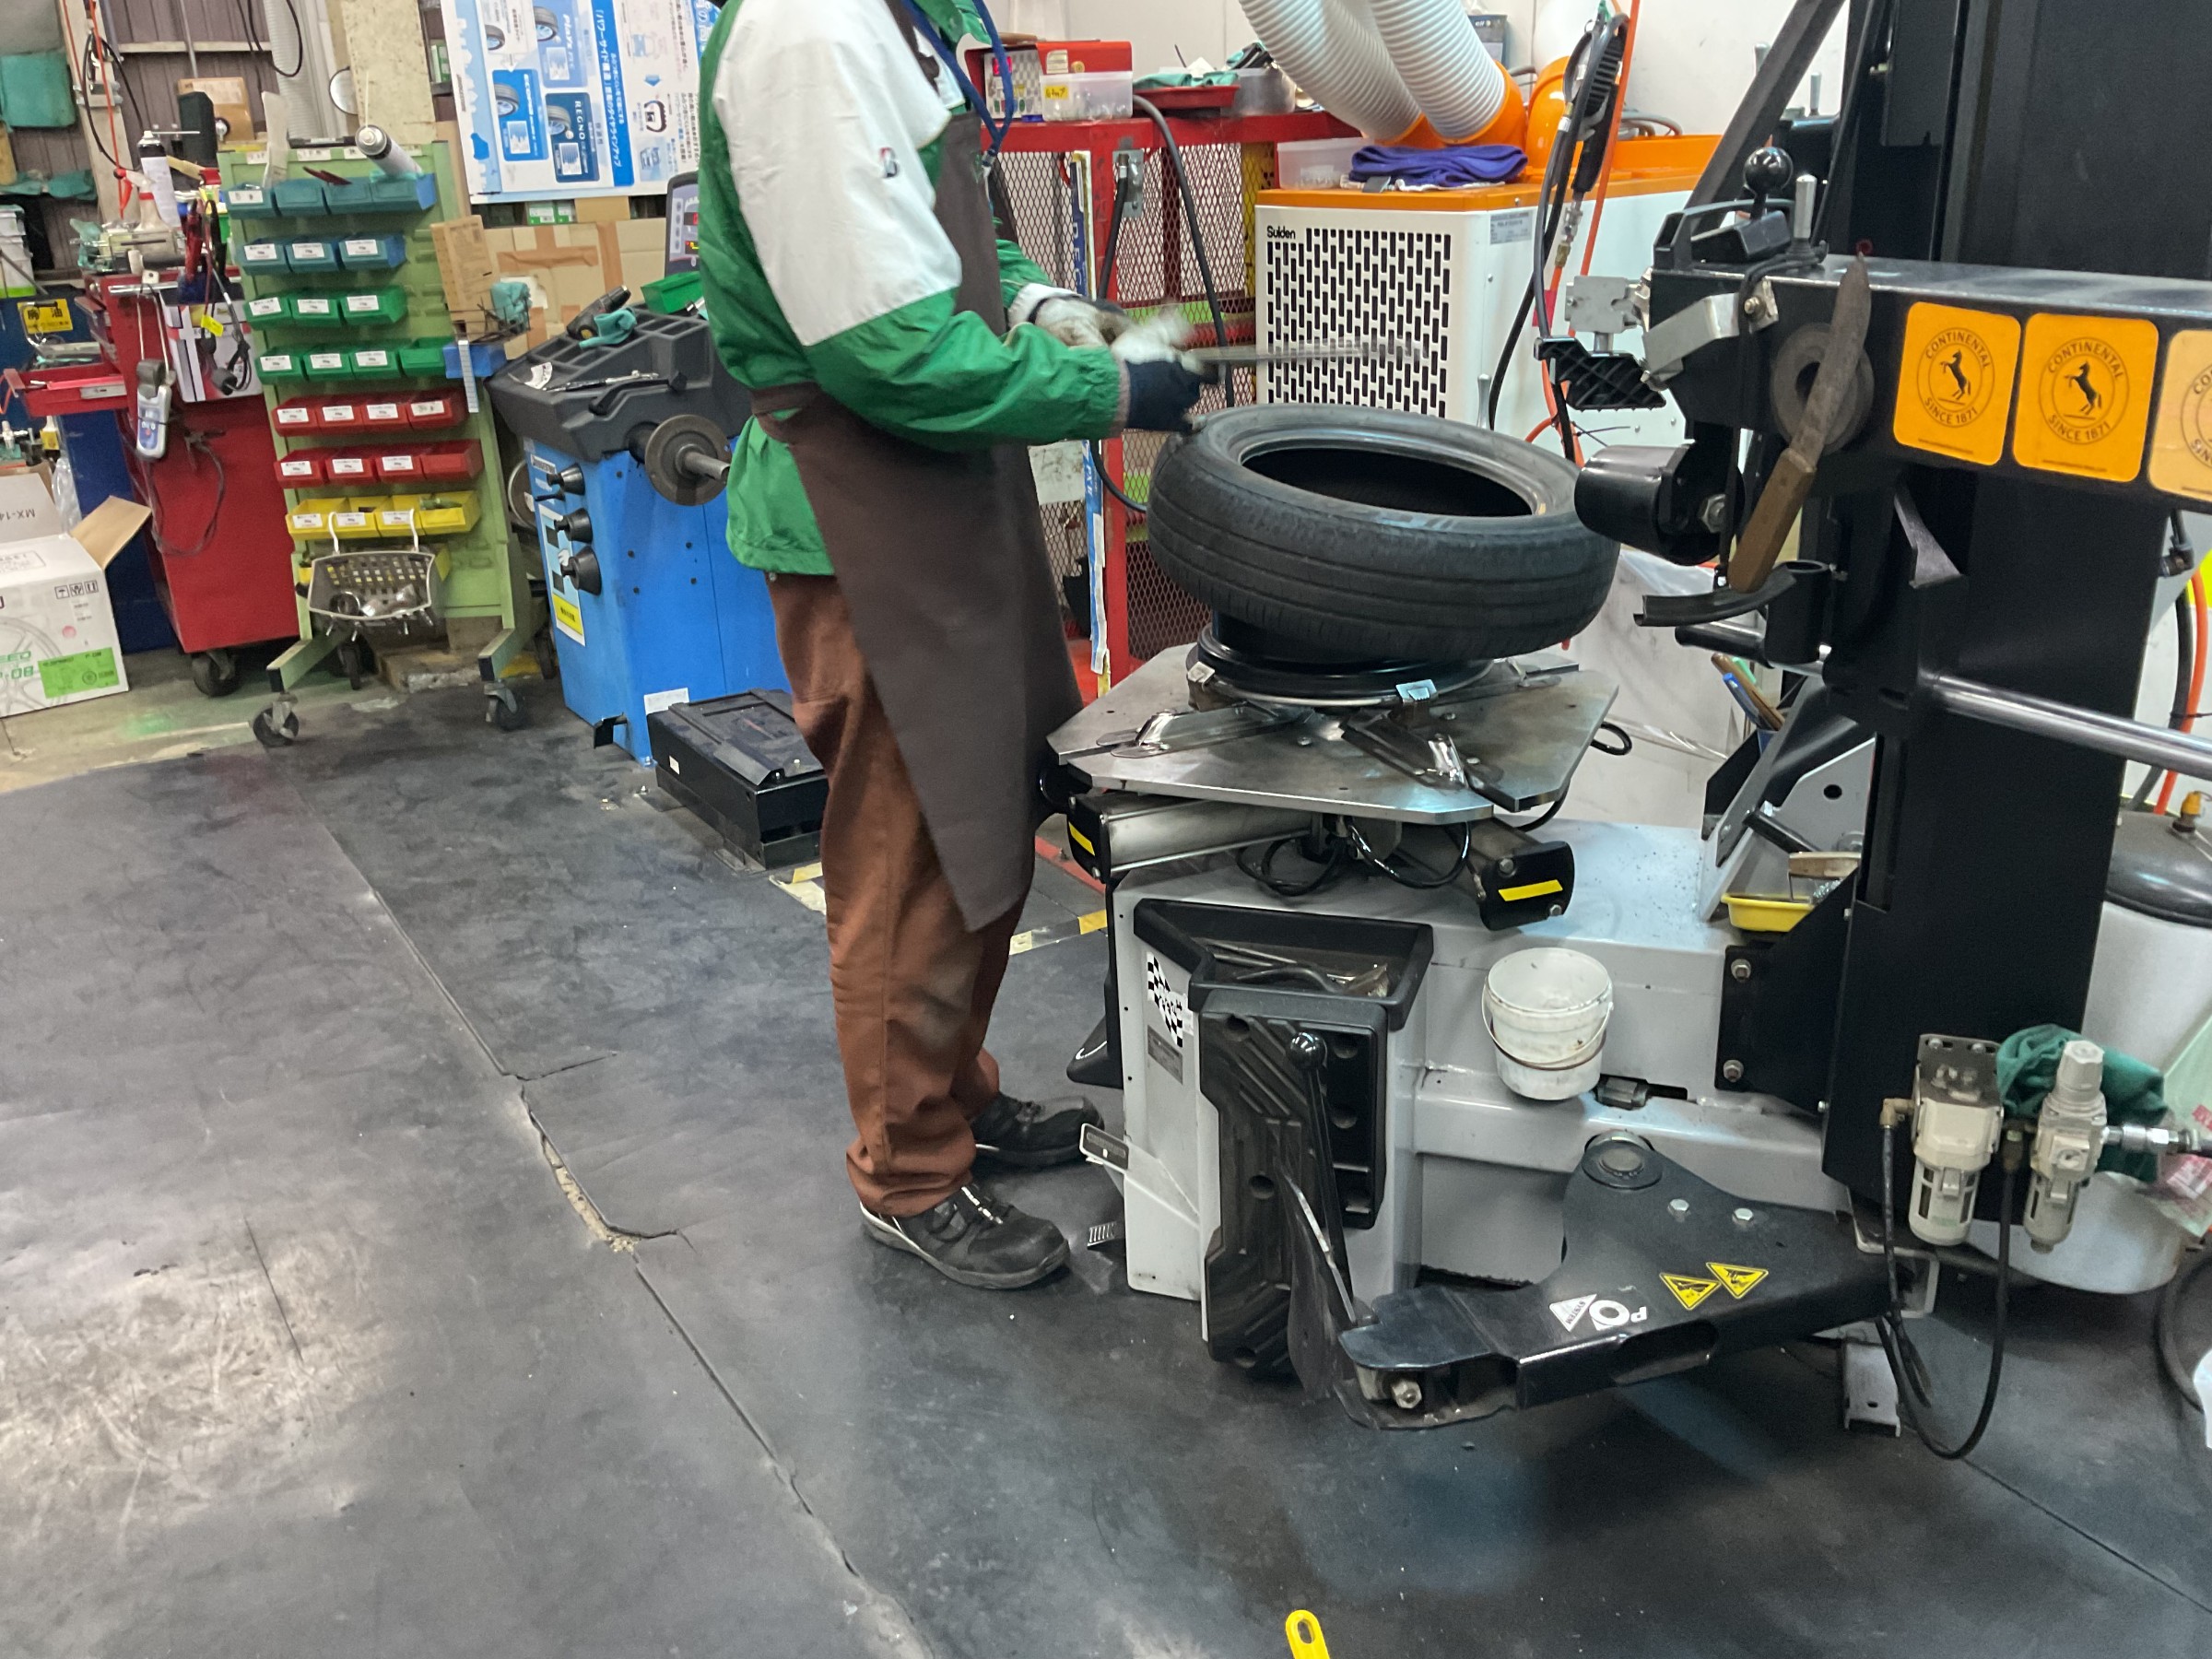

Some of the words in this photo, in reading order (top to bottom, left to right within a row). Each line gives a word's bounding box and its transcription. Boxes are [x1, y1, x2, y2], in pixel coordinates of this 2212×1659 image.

[575, 100, 586, 140] REGNO
[1925, 330, 1991, 369] CONTINENTAL
[2047, 340, 2124, 380] CONTINENTAL
[1924, 396, 1953, 424] SINCE
[1955, 406, 1978, 424] 1871
[2048, 414, 2082, 442] SINCE
[2085, 421, 2112, 441] 1871
[1565, 1300, 1585, 1324] SYSTEM
